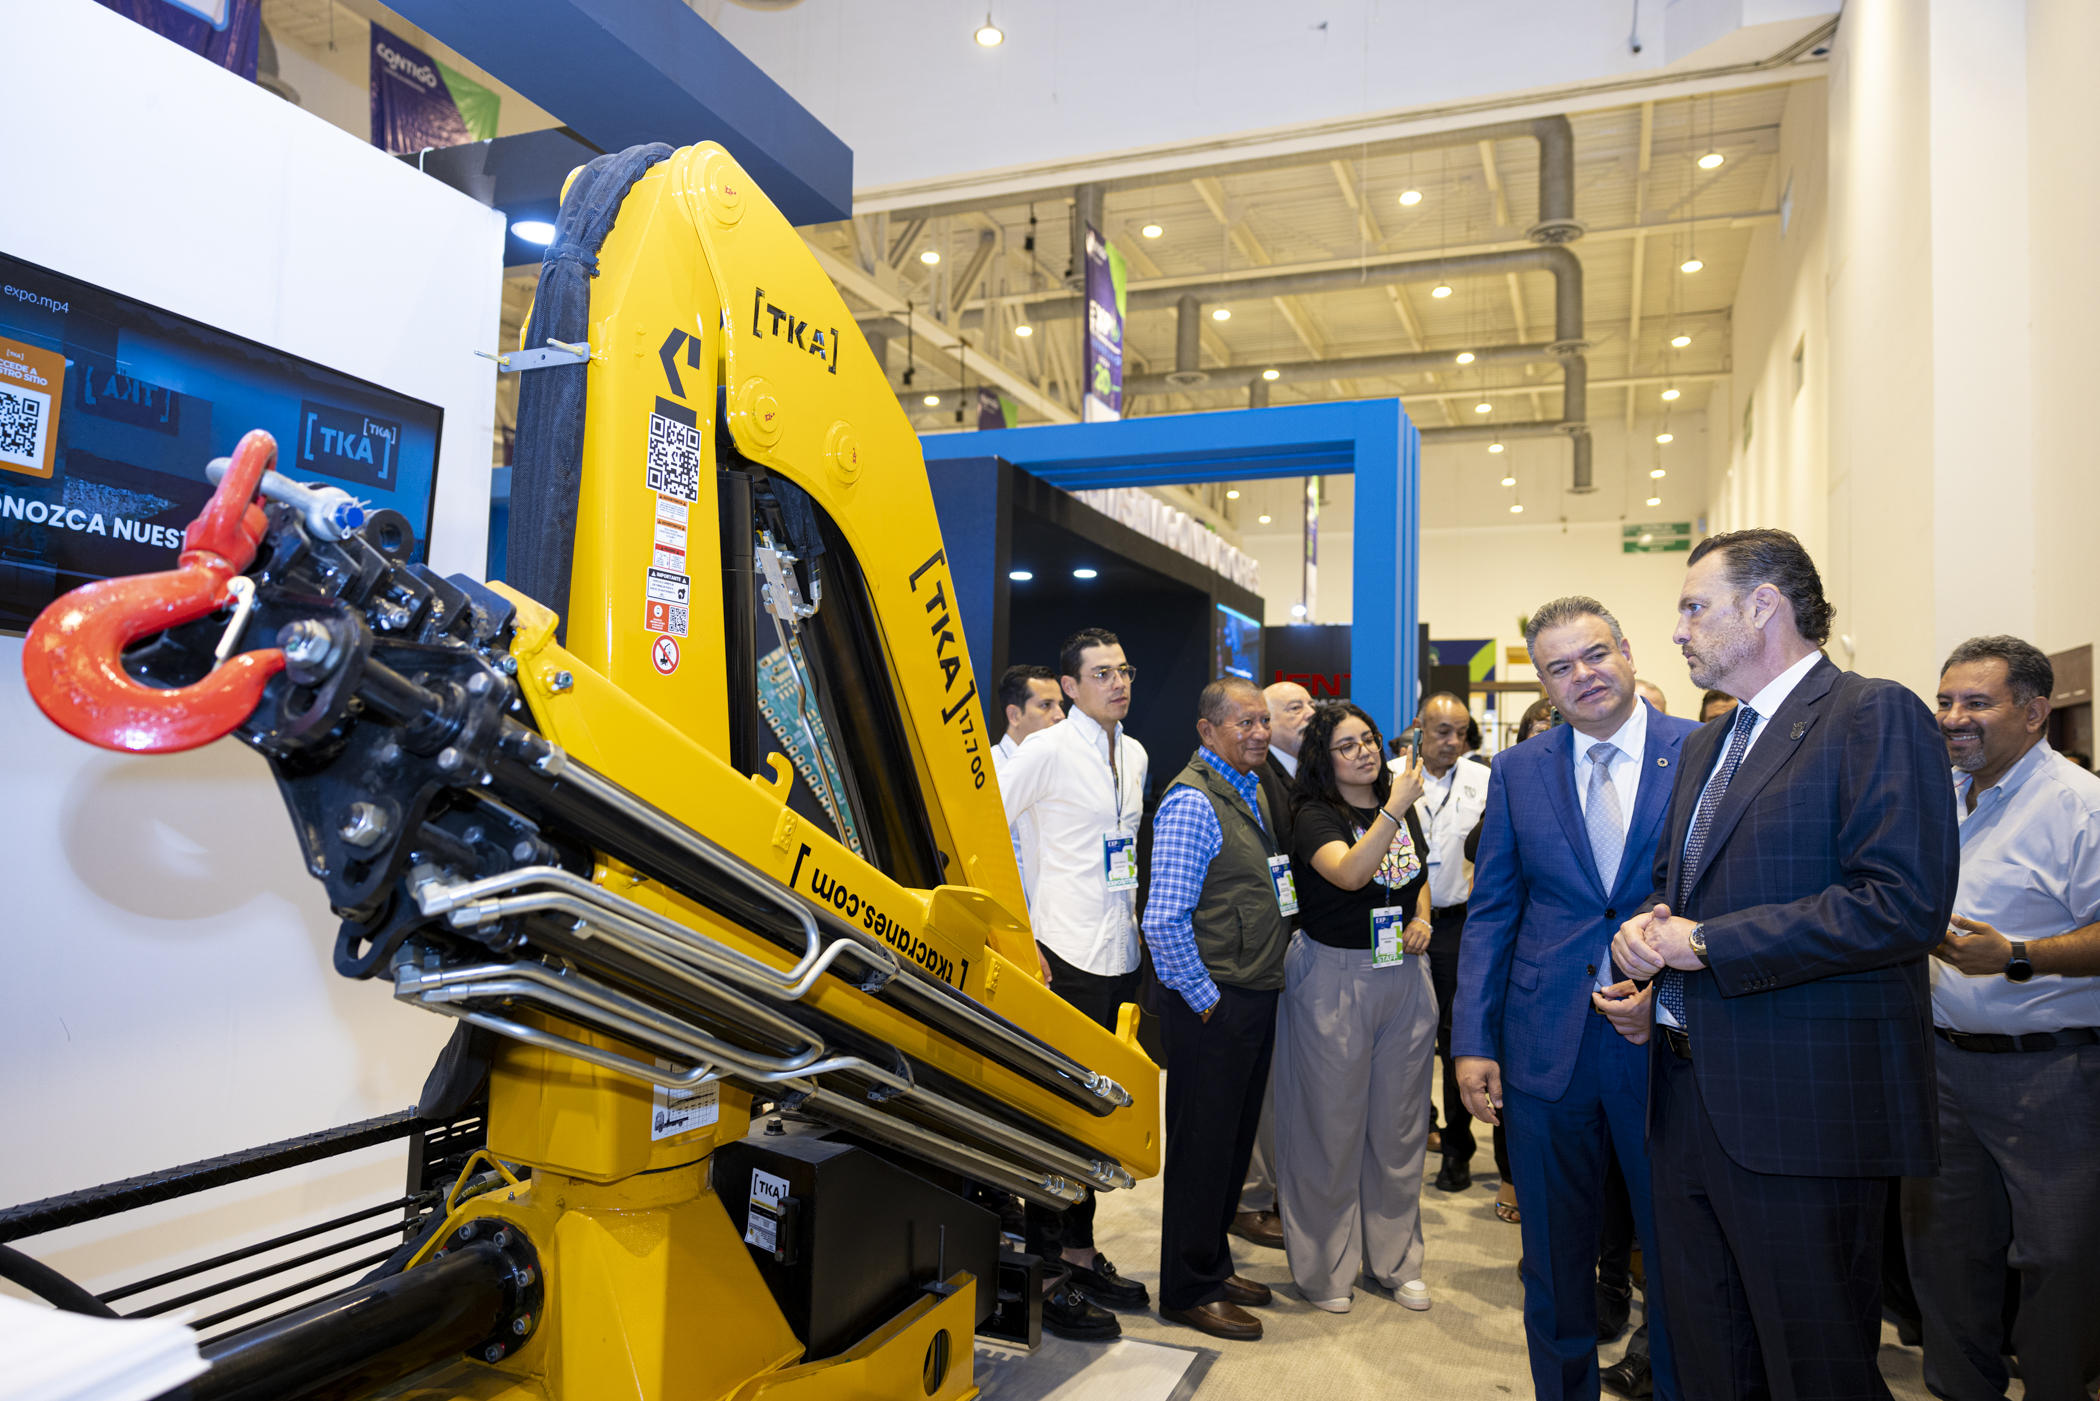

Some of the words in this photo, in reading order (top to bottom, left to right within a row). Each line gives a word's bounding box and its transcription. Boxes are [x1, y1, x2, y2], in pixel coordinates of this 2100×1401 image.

[376, 42, 438, 88] CONTIGO
[4, 284, 69, 313] expo.mp4
[23, 373, 48, 386] SITIO
[30, 367, 38, 376] A
[0, 495, 107, 536] NOZCA
[656, 571, 682, 583] IMPORTANTE
[959, 708, 986, 790] 17.700
[1377, 954, 1398, 963] STAFF
